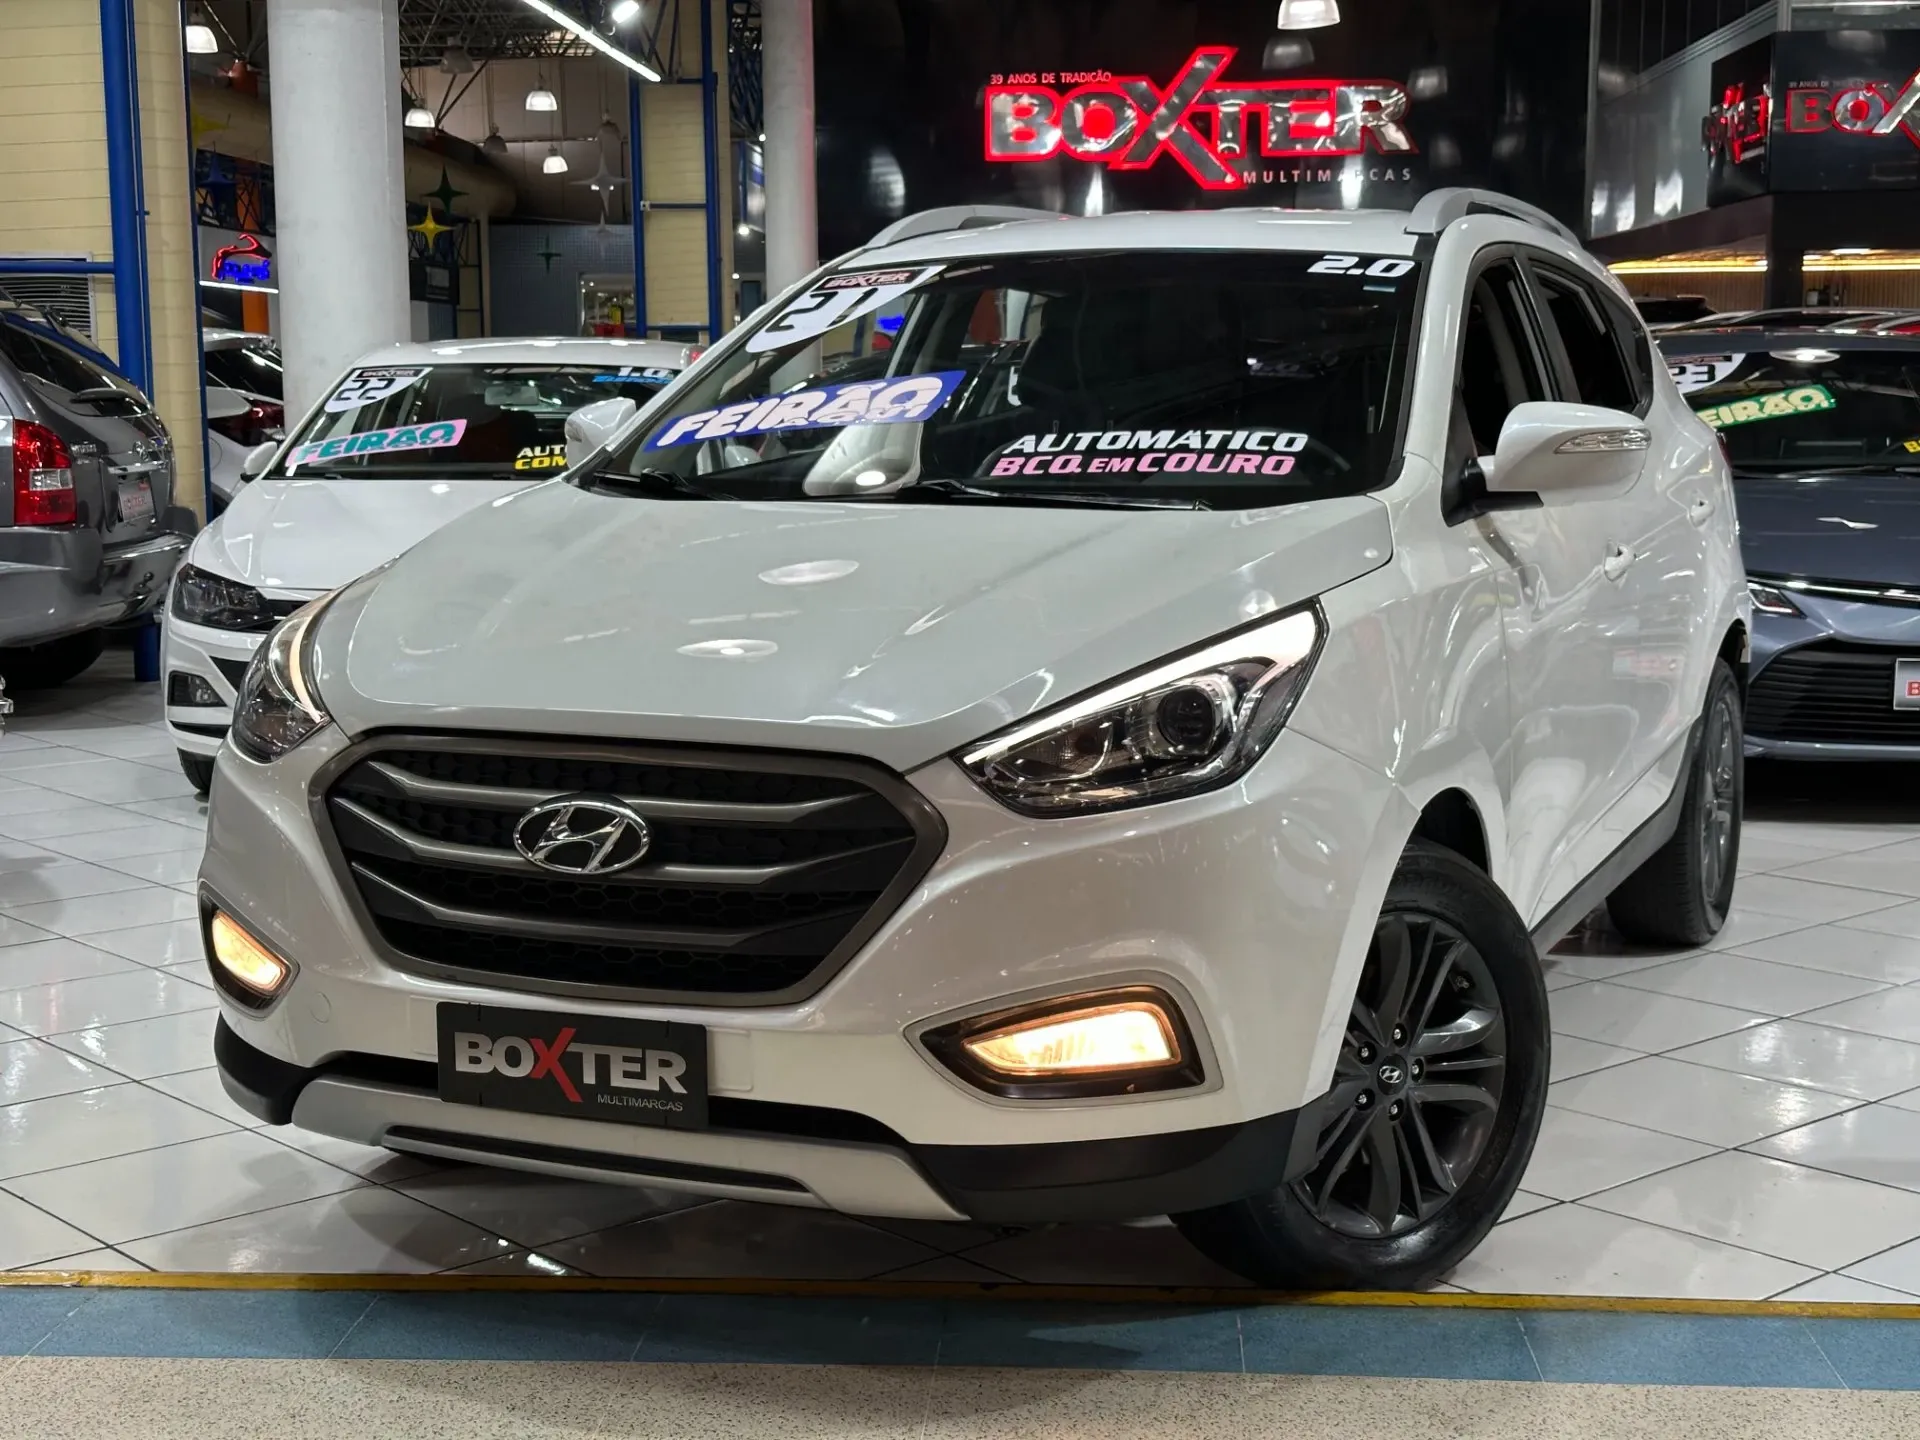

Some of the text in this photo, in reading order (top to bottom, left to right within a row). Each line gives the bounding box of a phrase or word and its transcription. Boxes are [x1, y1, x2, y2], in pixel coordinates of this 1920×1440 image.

[990, 74, 1003, 84] 39
[1007, 73, 1037, 84] ANOS
[1041, 72, 1056, 83] DE
[984, 46, 1418, 189] BOXTER
[1306, 254, 1415, 277] 2.0
[764, 287, 879, 332] 21
[332, 378, 397, 401] 22
[656, 376, 943, 447] FEIRÃO
[1086, 457, 1136, 473] EM
[1137, 452, 1296, 475] COURO
[454, 1027, 688, 1103] BOXTER
[597, 1093, 684, 1112] MULTIMARCAS
